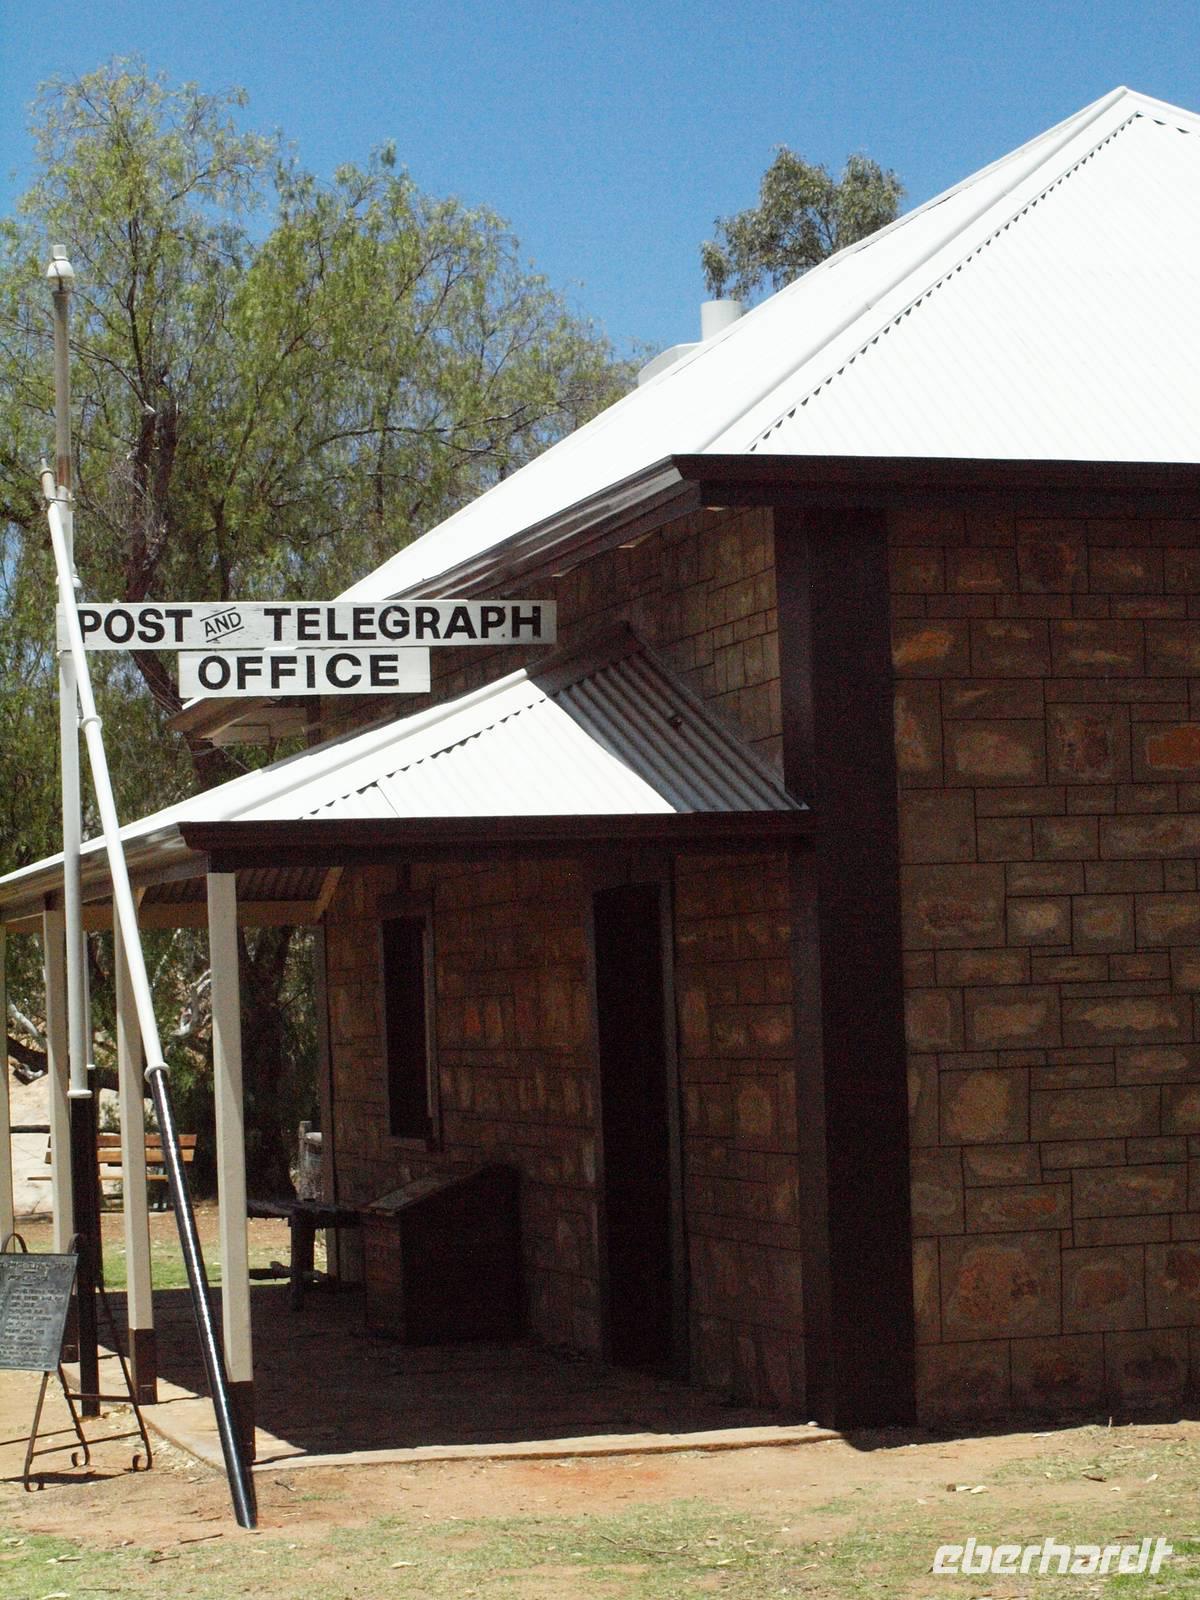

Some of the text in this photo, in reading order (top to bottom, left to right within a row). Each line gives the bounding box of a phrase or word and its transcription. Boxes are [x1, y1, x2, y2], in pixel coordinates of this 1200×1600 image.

[78, 605, 541, 644] POST AND TELEGRAPH
[198, 654, 400, 690] OFFICE
